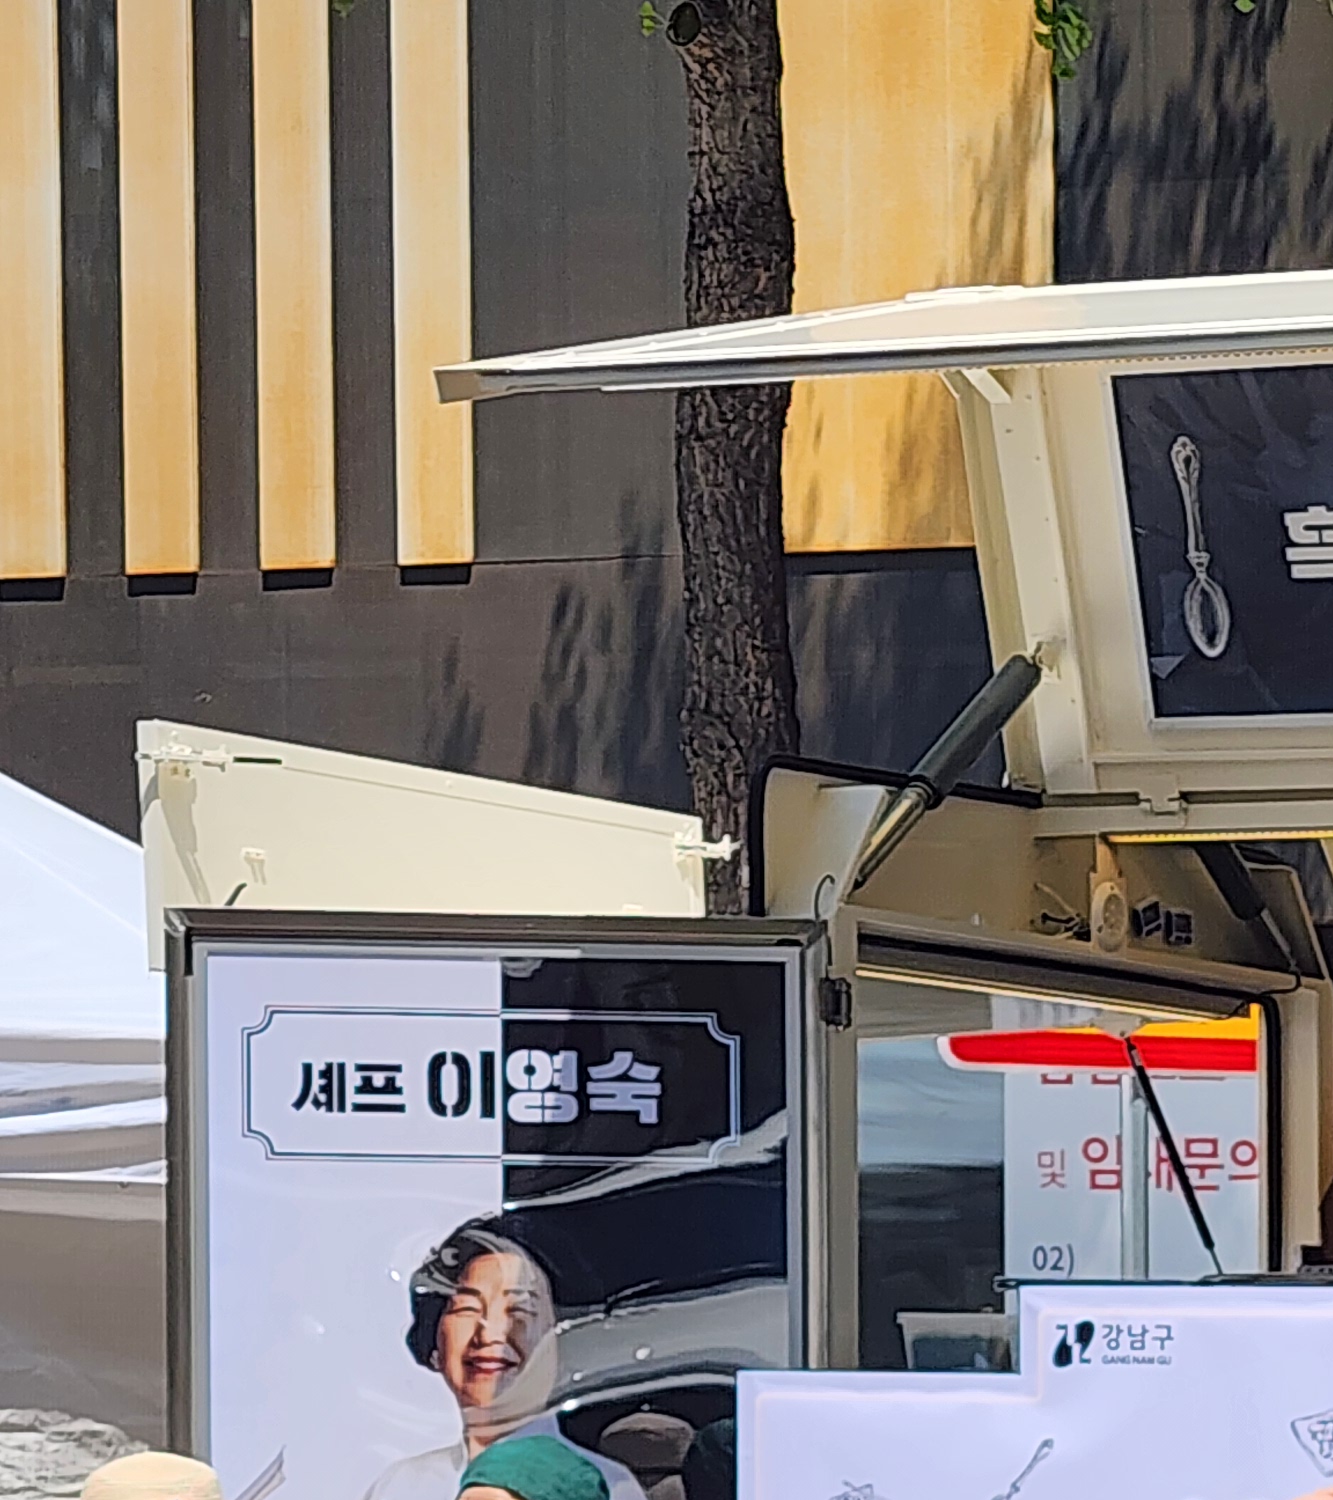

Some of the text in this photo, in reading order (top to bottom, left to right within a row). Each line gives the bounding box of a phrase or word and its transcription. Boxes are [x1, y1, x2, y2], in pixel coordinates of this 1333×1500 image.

[290, 1048, 663, 1125] 셰프 이영숙
[1101, 1323, 1175, 1351] 강남구
